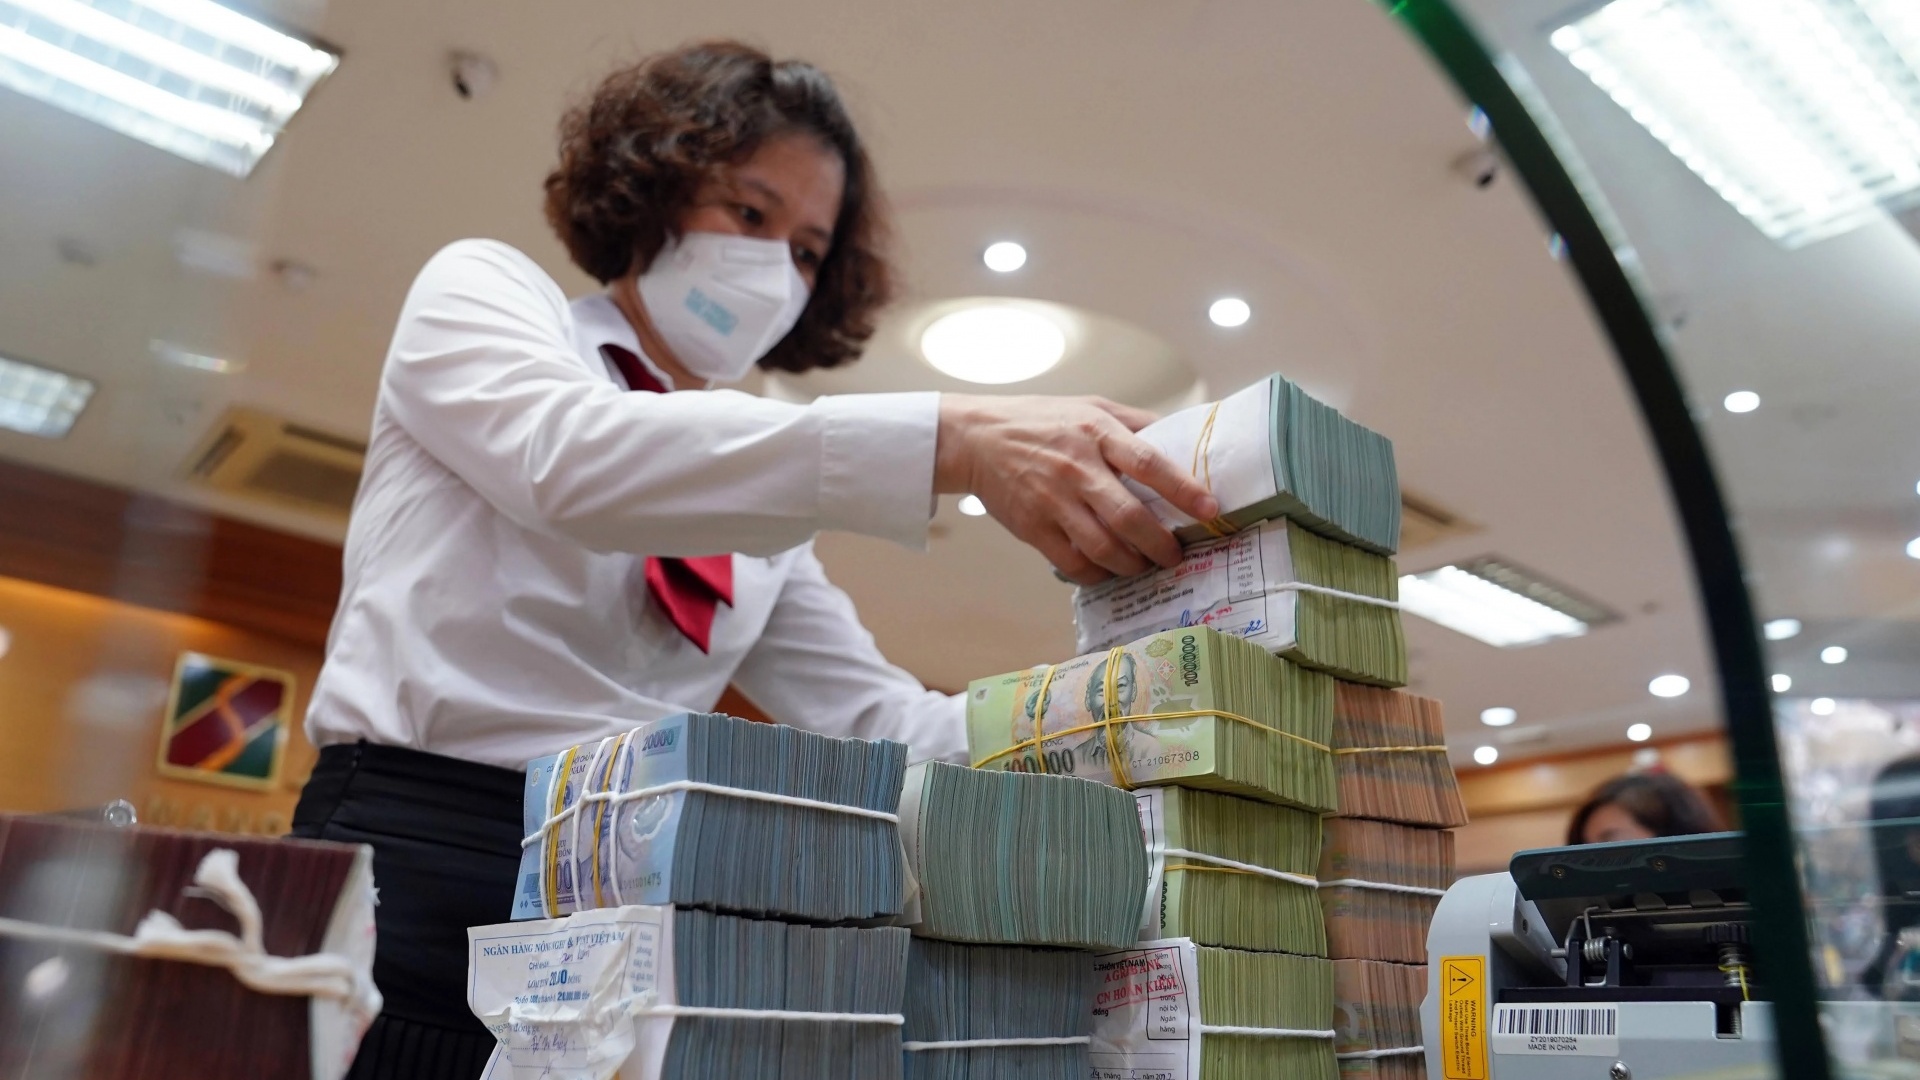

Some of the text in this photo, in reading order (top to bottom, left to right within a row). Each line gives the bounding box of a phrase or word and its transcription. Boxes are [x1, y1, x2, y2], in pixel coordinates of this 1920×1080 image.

[1182, 635, 1198, 687] 100000
[1147, 751, 1200, 766] 21067308
[483, 943, 509, 956] NGÂN
[512, 941, 533, 955] HÀNG
[1096, 991, 1111, 1005] CN
[1093, 1008, 1109, 1017] đồng
[1160, 1015, 1176, 1023] Ngân
[1160, 1026, 1176, 1034] hàng
